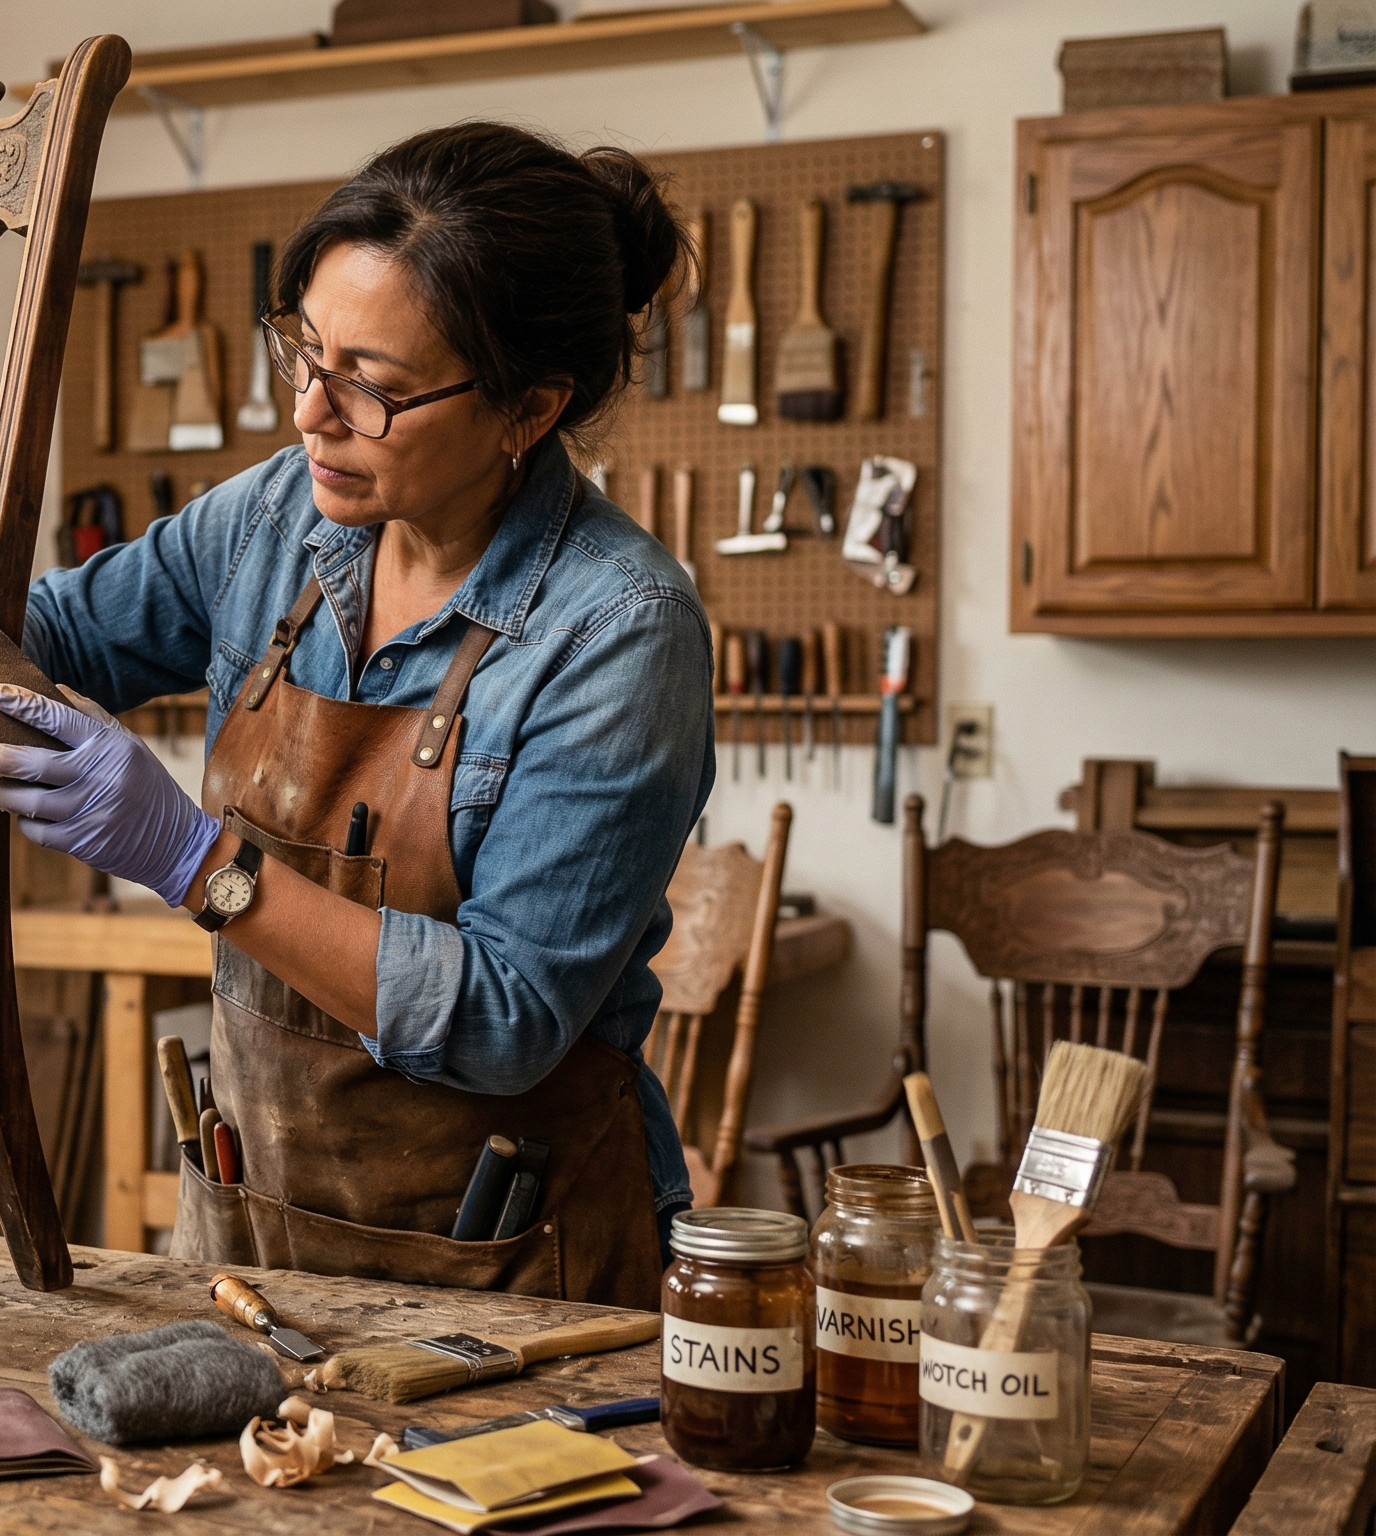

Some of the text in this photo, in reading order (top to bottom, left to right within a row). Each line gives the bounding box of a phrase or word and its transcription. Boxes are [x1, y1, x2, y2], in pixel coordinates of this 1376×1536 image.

[816, 1304, 920, 1345] VARNISH
[670, 1334, 780, 1375] STAINS
[1001, 1372, 1050, 1397] OIL
